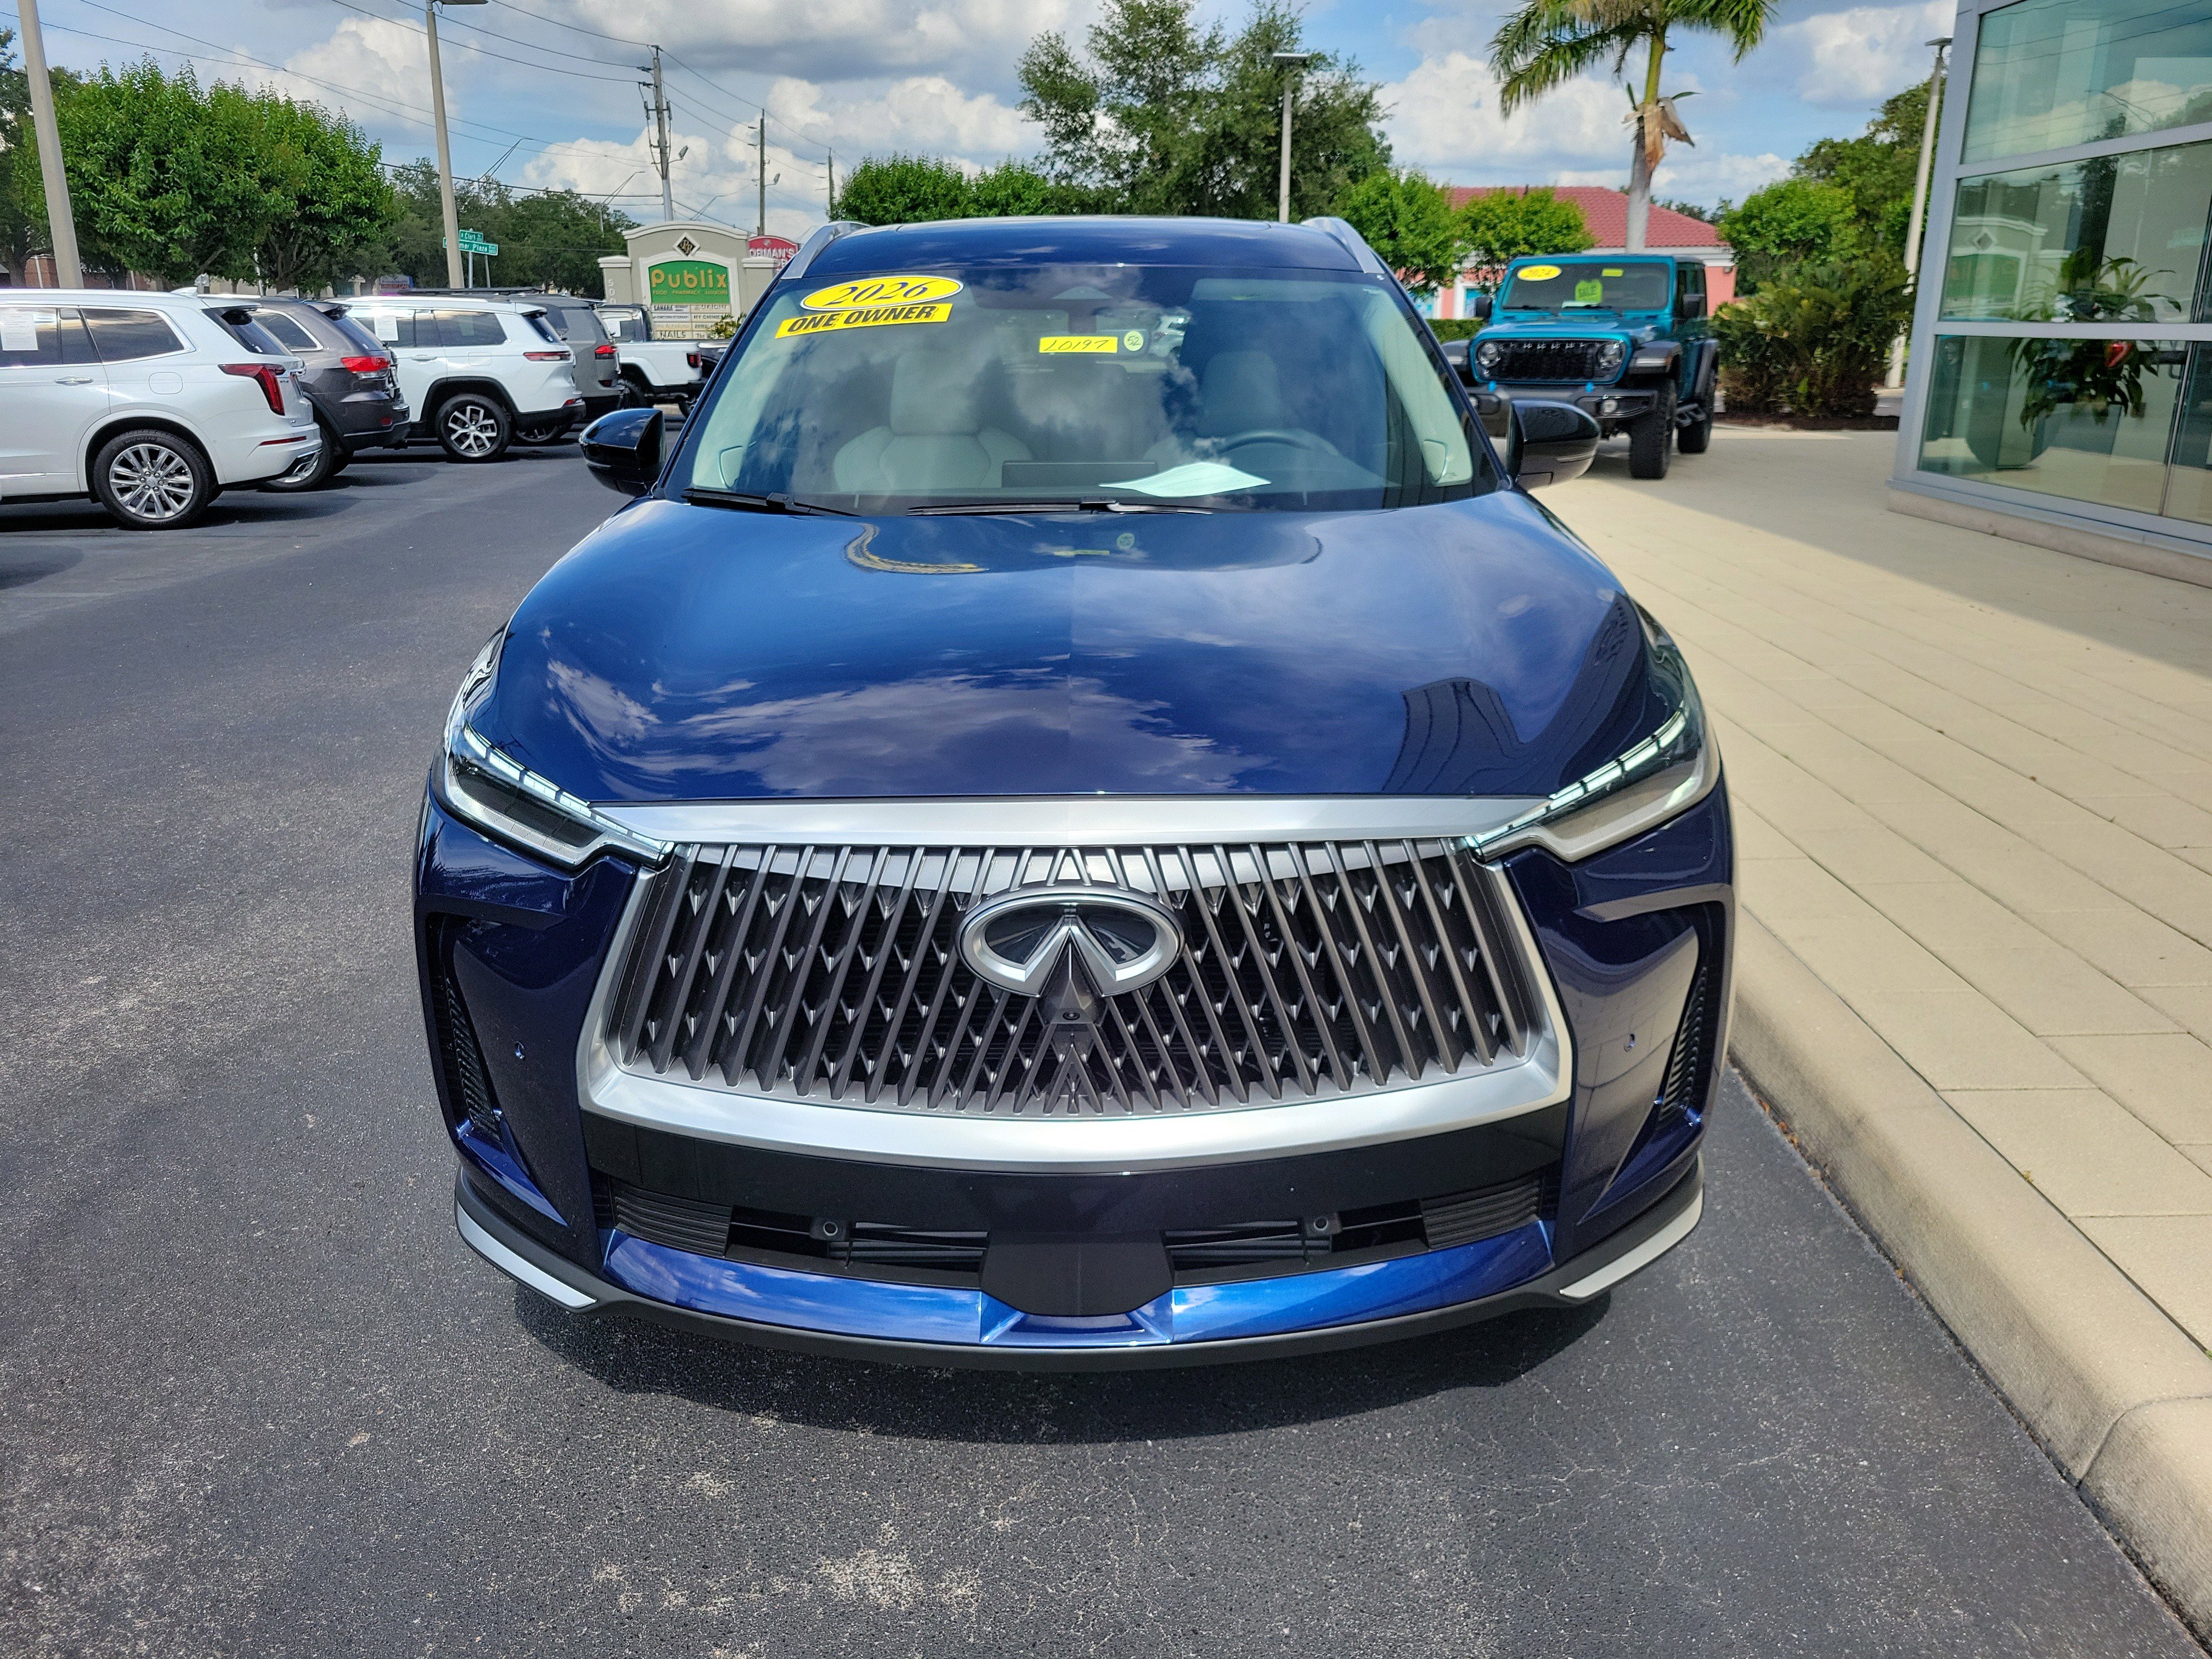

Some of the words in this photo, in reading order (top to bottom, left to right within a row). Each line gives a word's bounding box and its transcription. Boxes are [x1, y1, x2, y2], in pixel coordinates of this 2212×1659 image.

[465, 233, 476, 241] Clark
[472, 244, 487, 252] Plaza
[651, 269, 726, 288] Publix
[822, 280, 939, 307] 2026
[787, 313, 843, 332] ONE
[843, 306, 940, 325] OWNER
[1127, 335, 1141, 346] 52
